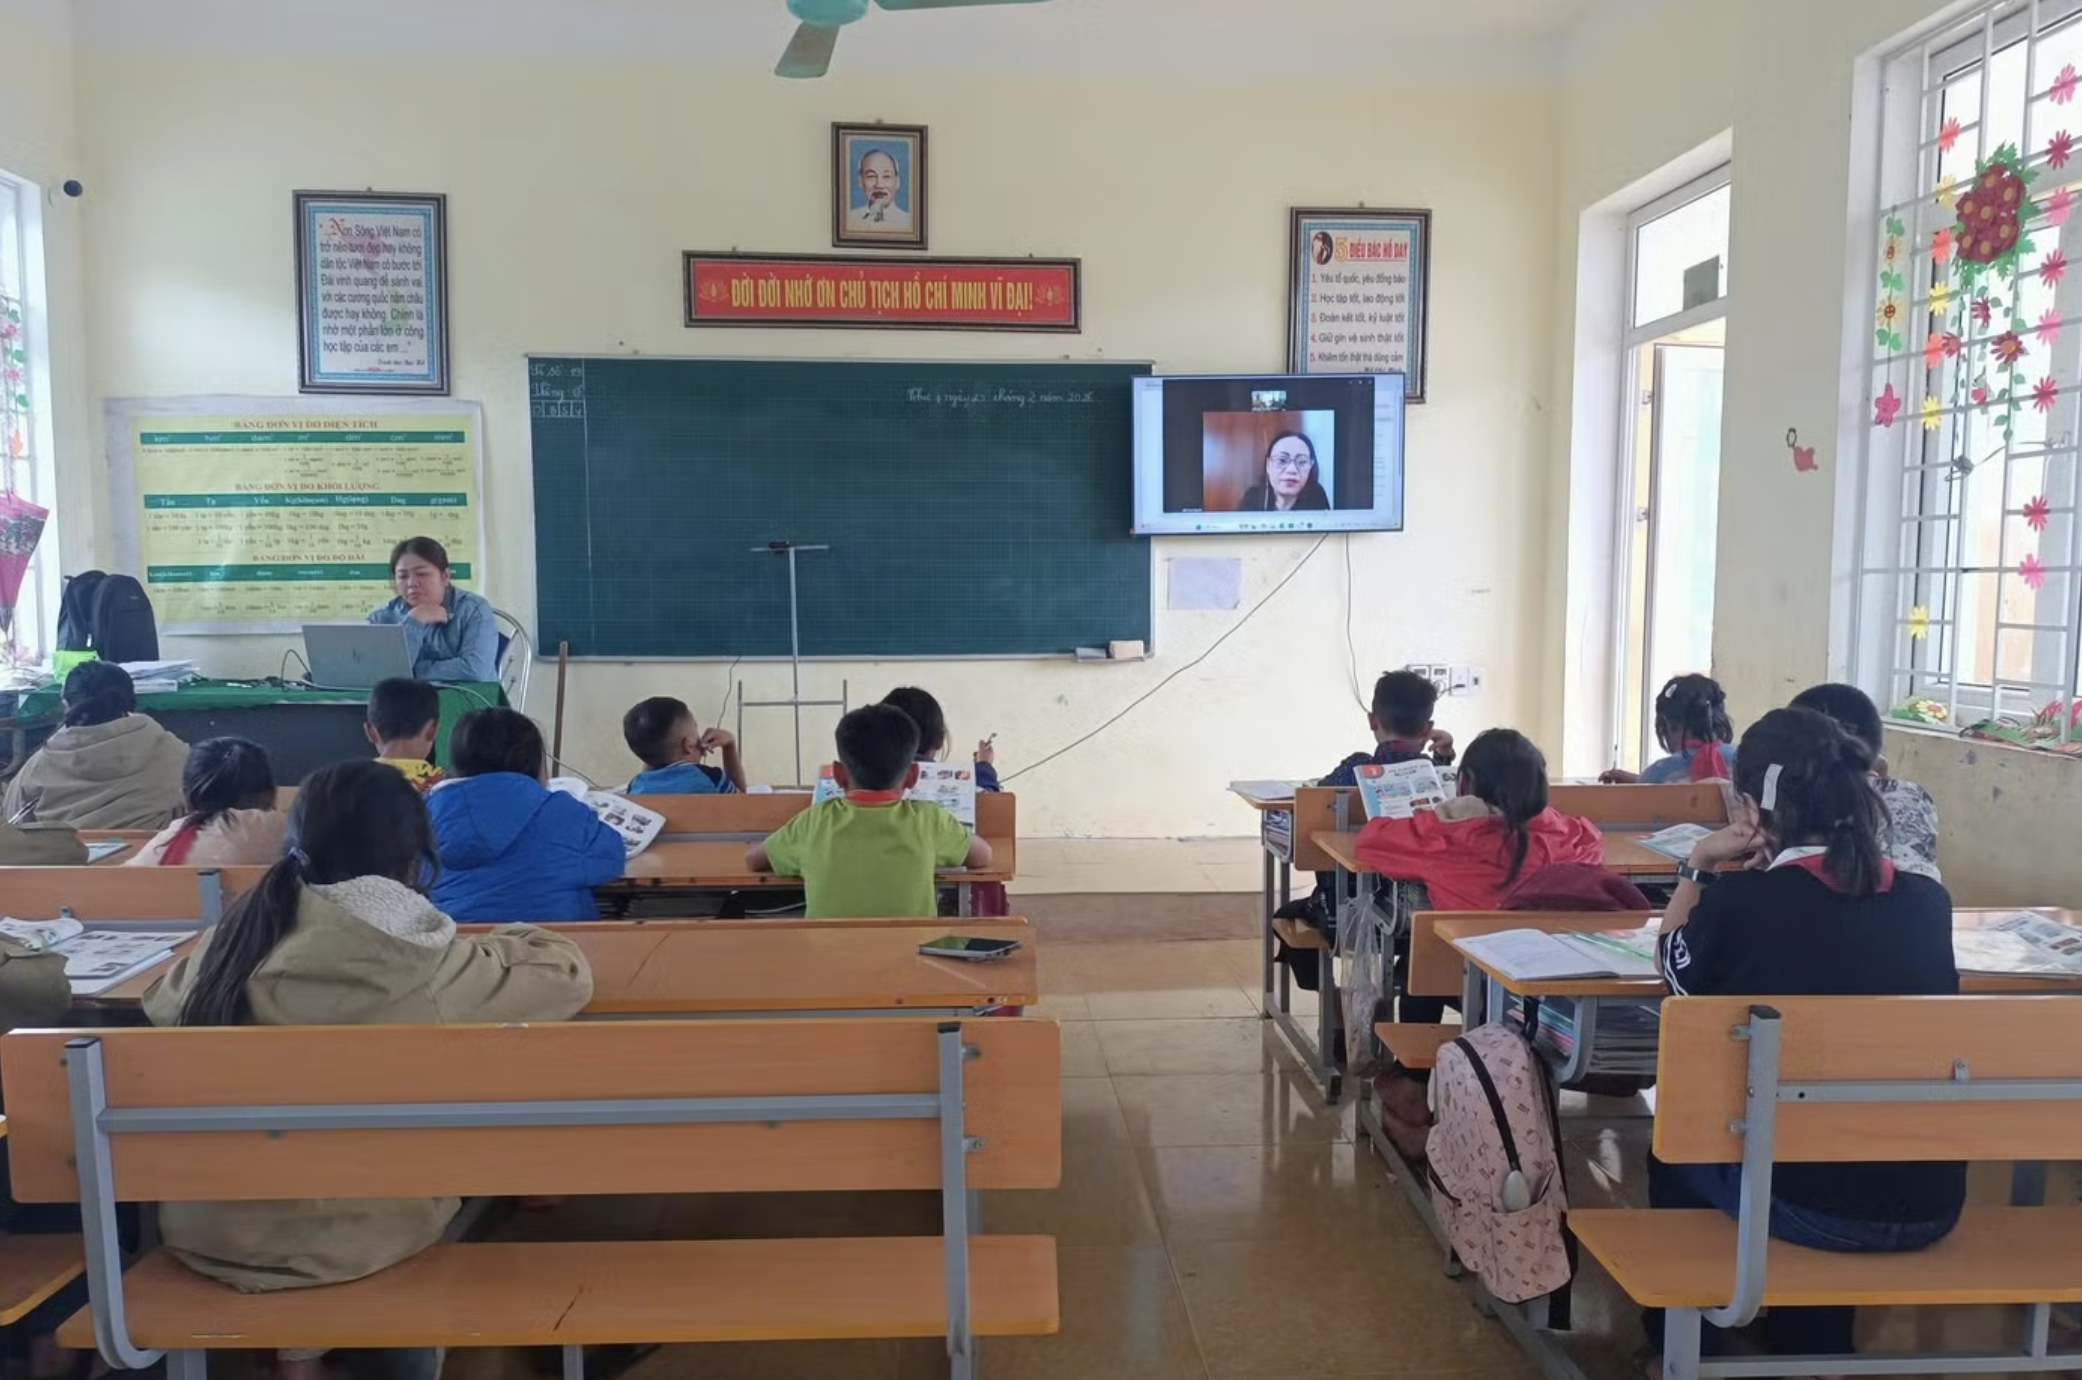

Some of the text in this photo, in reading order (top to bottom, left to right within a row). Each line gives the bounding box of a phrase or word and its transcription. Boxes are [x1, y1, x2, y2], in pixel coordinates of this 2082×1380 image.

[354, 224, 374, 239] Sông
[376, 225, 390, 238] Việt
[393, 227, 410, 236] Nam
[412, 225, 422, 238] có
[382, 243, 396, 255] hay
[398, 243, 422, 257] không
[1335, 237, 1347, 262] 5
[363, 259, 380, 269] Nam
[353, 276, 377, 289] quang
[379, 272, 389, 286] để
[1320, 273, 1333, 283] Yêu
[1362, 274, 1374, 285] yêu
[731, 272, 754, 307] ĐỜI
[758, 272, 780, 308] ĐỜI
[785, 273, 814, 309] NHỚ
[839, 270, 866, 309] CHỦ
[870, 280, 900, 315] TỊCH
[903, 271, 923, 310] HỒ
[925, 275, 948, 310] CHÍ
[951, 282, 986, 311] MINH
[990, 277, 1003, 311] VĨ
[1006, 282, 1033, 317] ĐẠI!
[1320, 293, 1335, 304] Học
[1363, 293, 1374, 303] lao
[1375, 293, 1394, 305] động
[345, 308, 360, 322] hay
[358, 322, 378, 337] phần
[1310, 333, 1317, 343] 4.
[1360, 333, 1375, 342] sinh
[323, 341, 338, 354] học
[354, 339, 368, 352] của
[370, 343, 384, 352] các
[993, 387, 1025, 408] tháng
